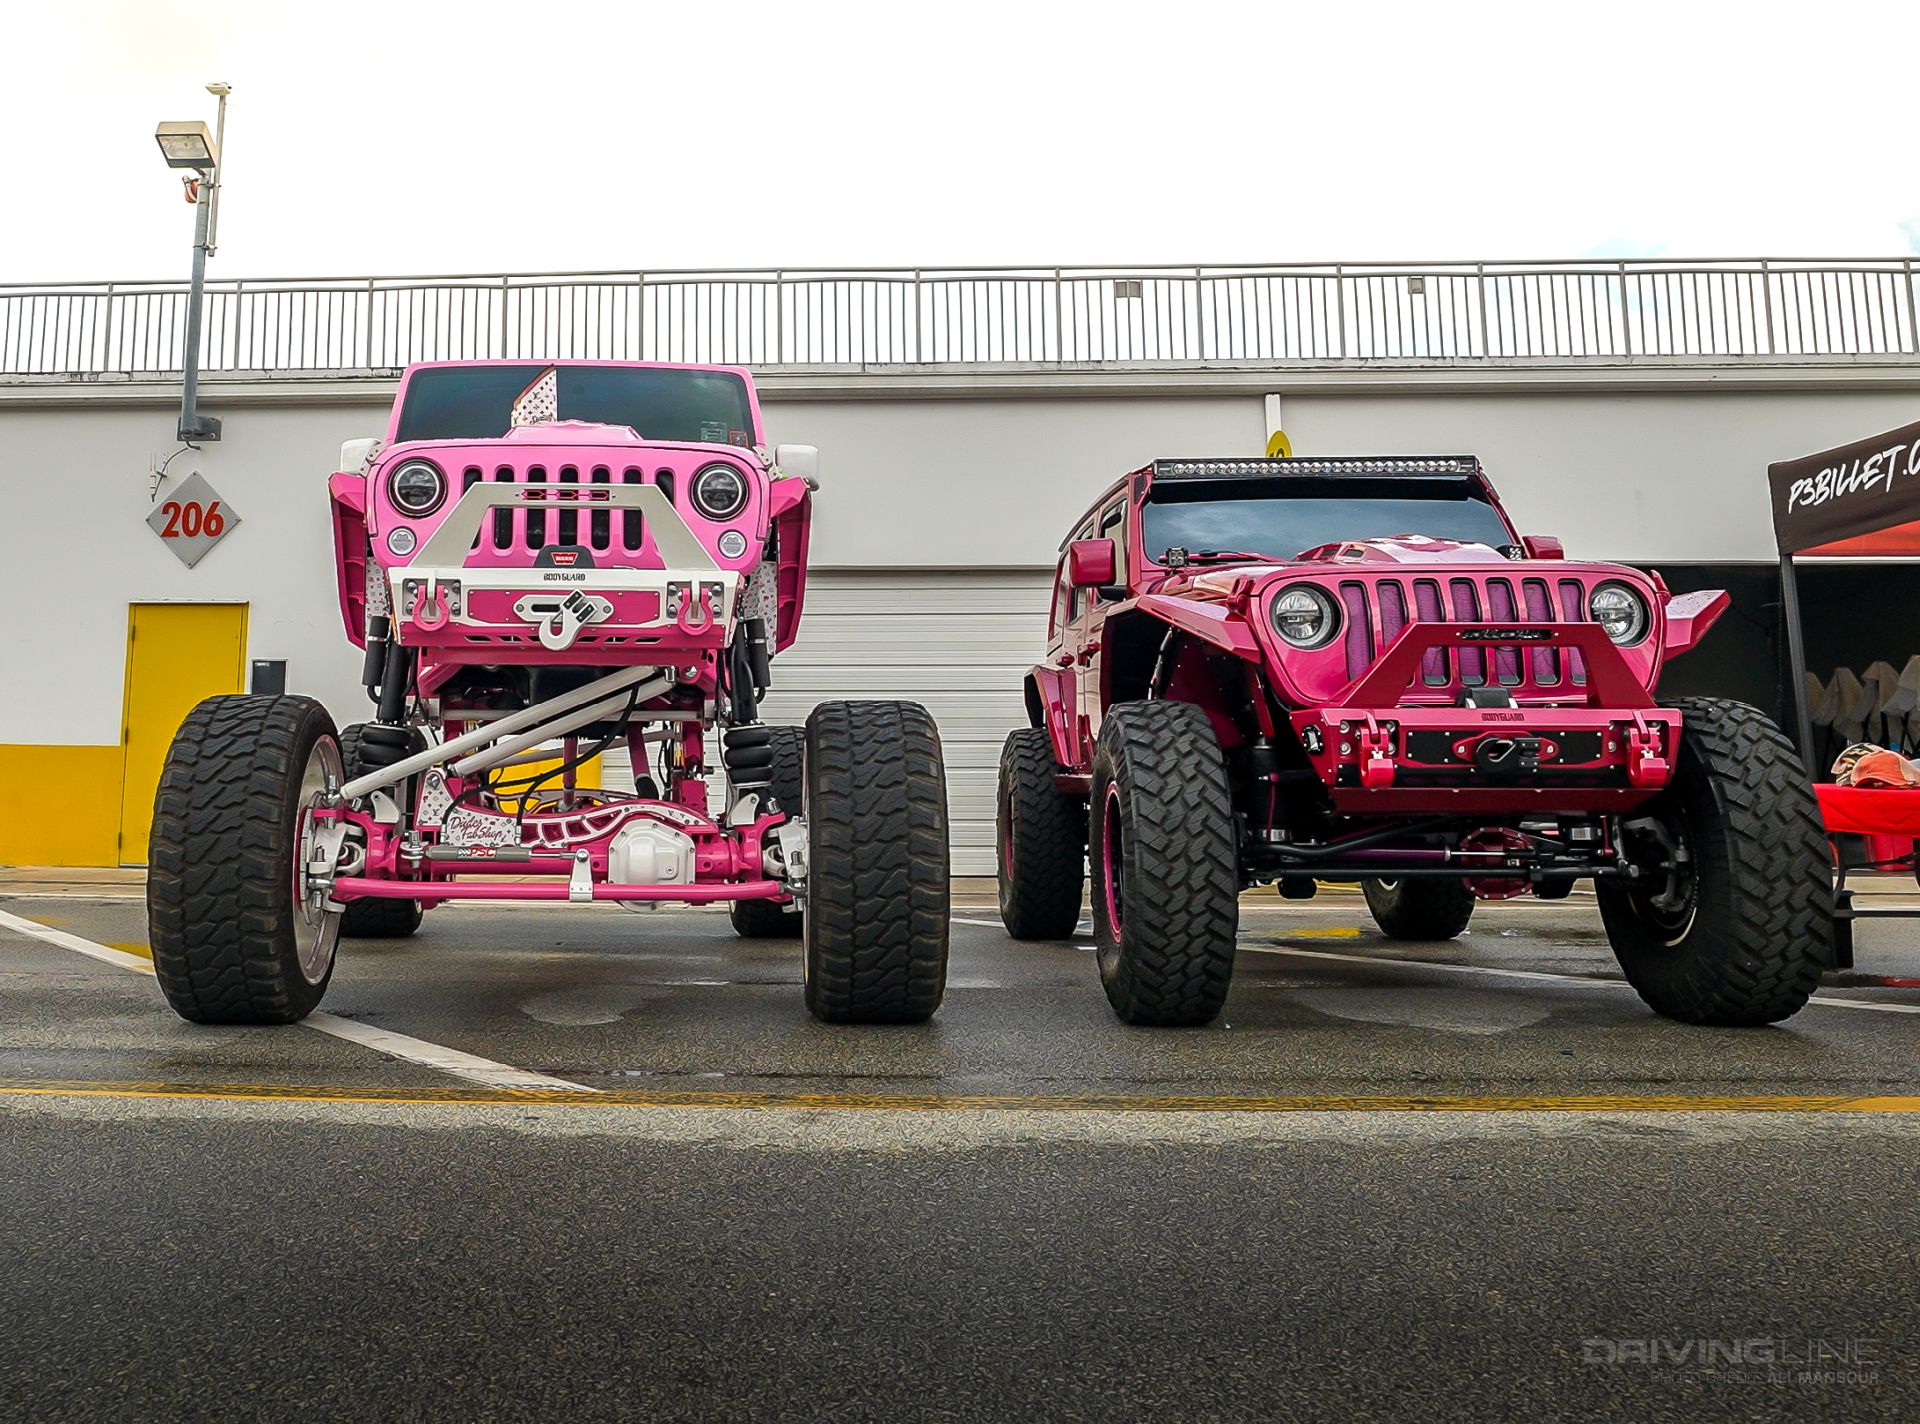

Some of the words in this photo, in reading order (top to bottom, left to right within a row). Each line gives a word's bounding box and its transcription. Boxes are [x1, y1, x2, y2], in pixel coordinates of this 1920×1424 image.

[160, 501, 224, 537] 206
[543, 573, 586, 581] BODYGUARD
[1481, 712, 1525, 721] BODYGUARD
